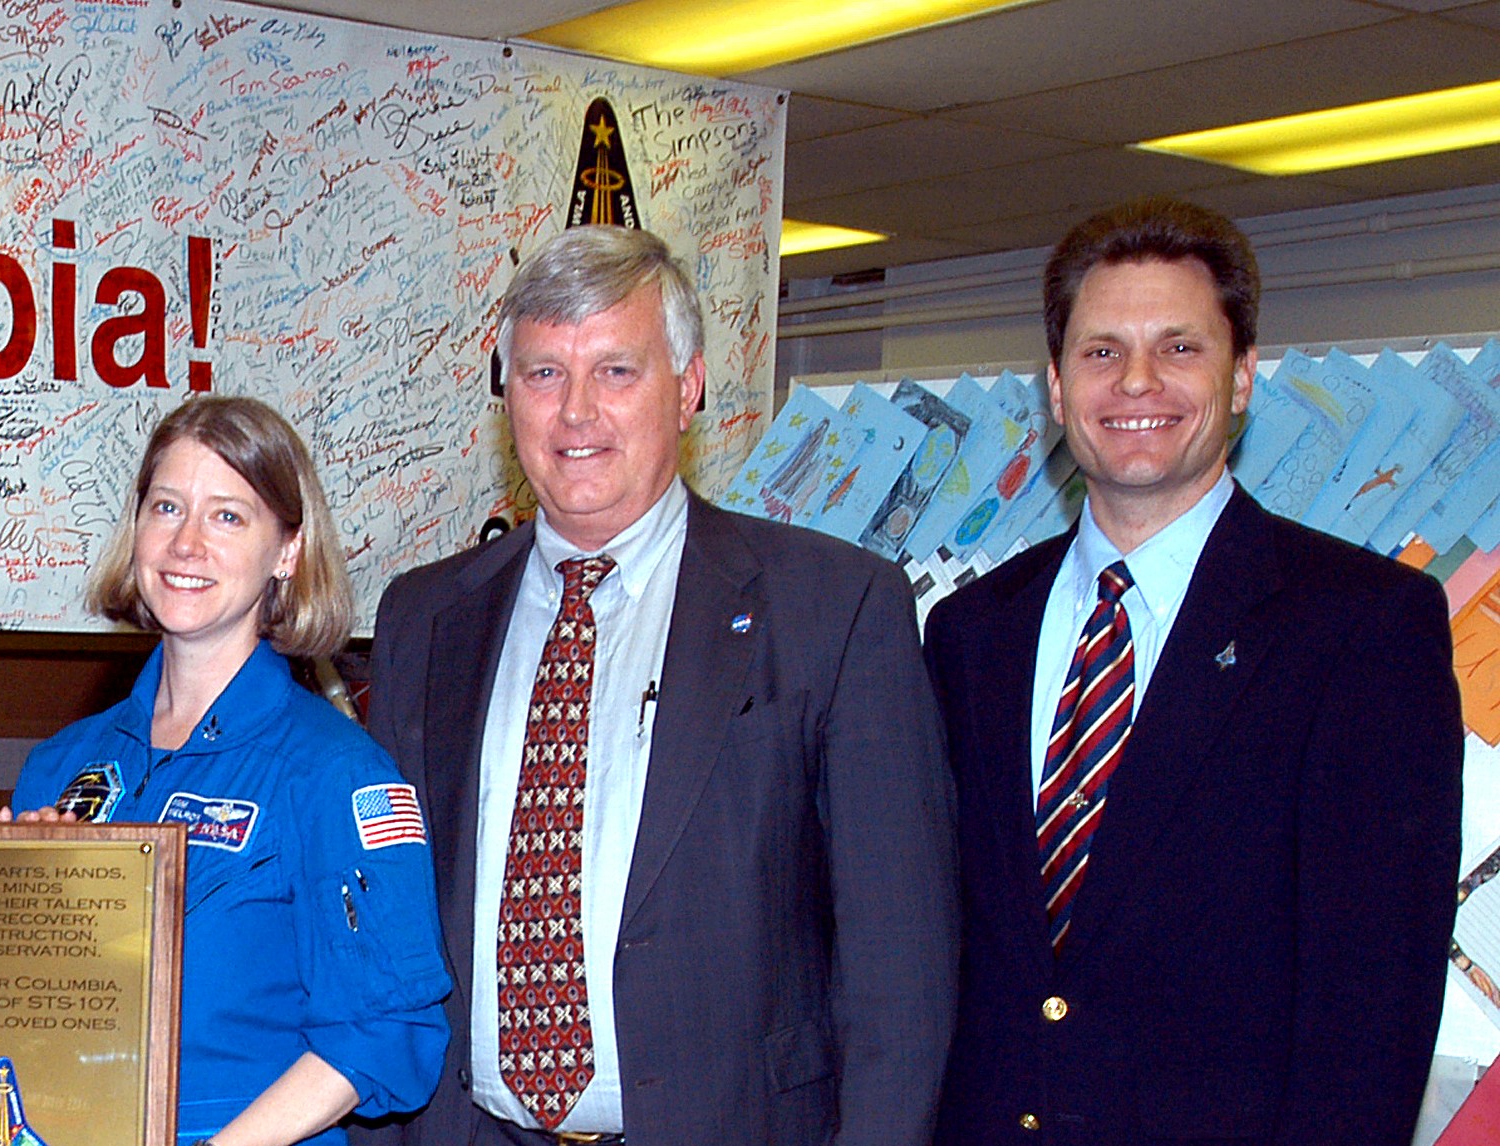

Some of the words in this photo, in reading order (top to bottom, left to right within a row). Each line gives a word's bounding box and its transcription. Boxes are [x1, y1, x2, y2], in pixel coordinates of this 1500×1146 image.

[630, 101, 684, 132] The
[55, 867, 126, 881] HANDS,
[3, 882, 63, 895] MINDS
[44, 898, 127, 911] TALENTS
[15, 976, 123, 993] COLUMBIA,
[28, 996, 119, 1013] STS-107,
[62, 1017, 121, 1031] ONES.
